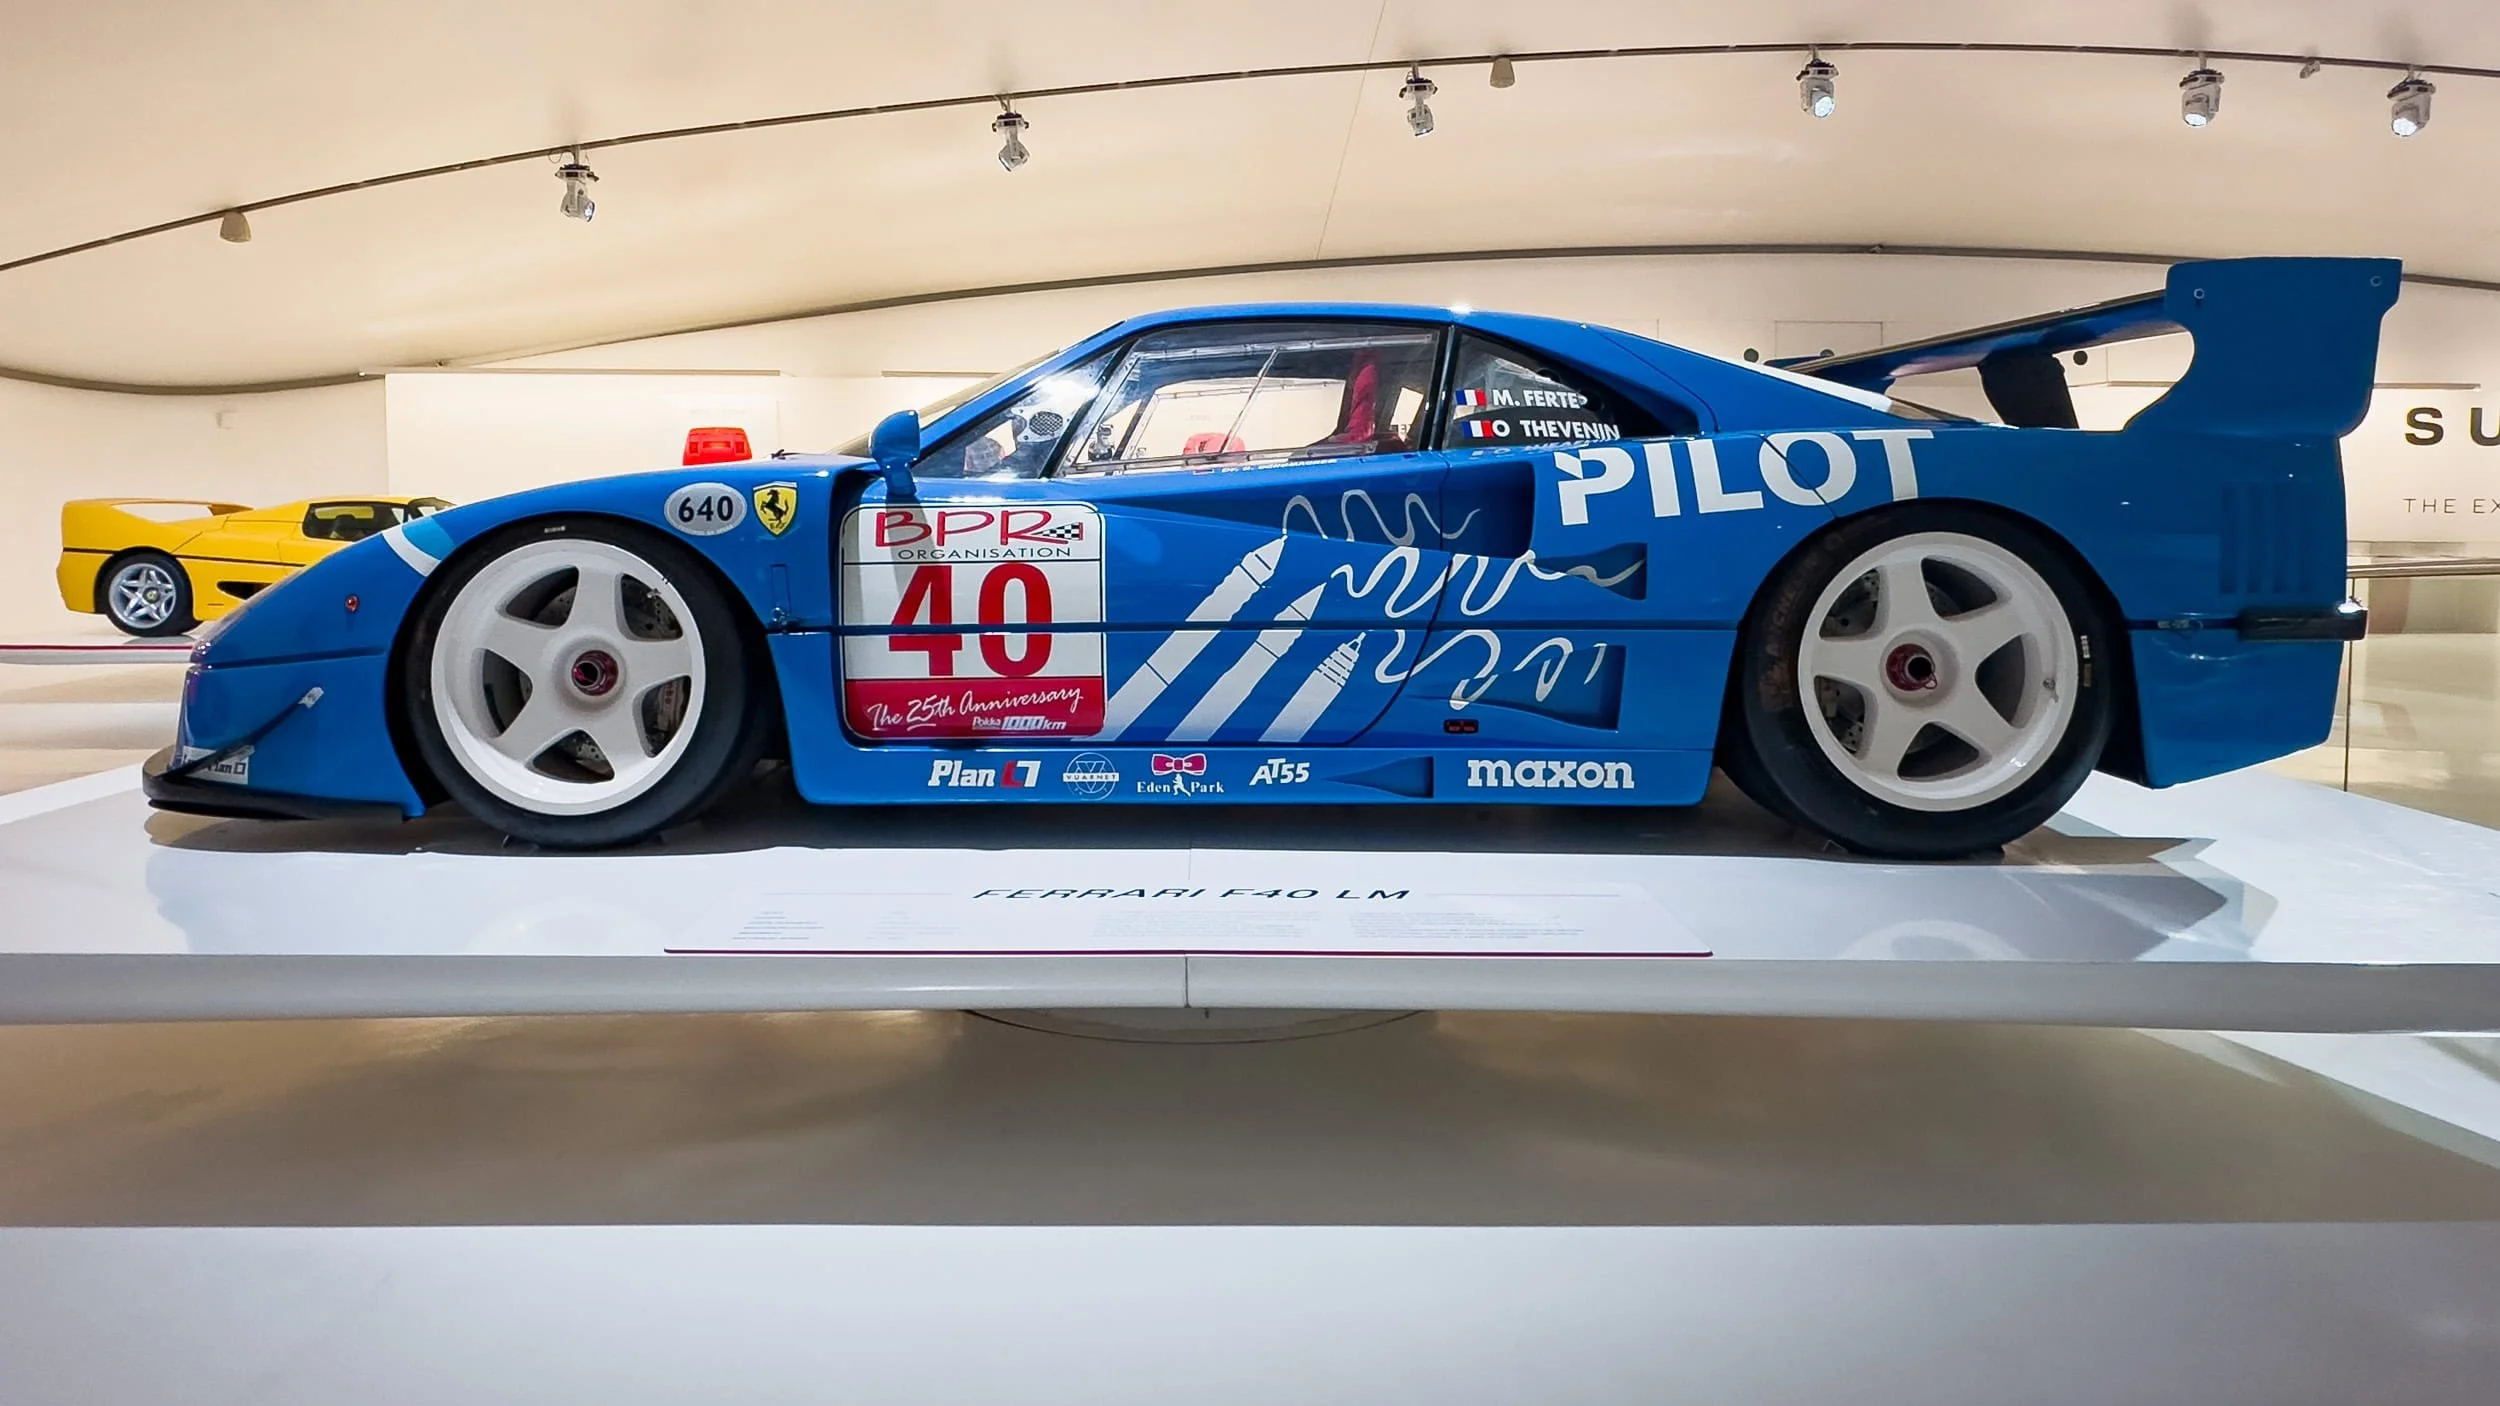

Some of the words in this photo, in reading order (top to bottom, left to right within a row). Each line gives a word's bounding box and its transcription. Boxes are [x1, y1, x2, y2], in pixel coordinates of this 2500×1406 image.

[1492, 389, 1521, 407] M.
[1519, 420, 1621, 441] THEVENIN
[1555, 429, 1934, 526] PILOT
[678, 495, 734, 523] 640
[2403, 498, 2457, 514] THE
[876, 510, 1069, 547] BPR
[898, 547, 1071, 560] ORGANISATION
[889, 562, 1053, 677] 40
[867, 703, 903, 731] The
[907, 695, 955, 725] 25th
[959, 687, 1084, 714] Anniversary
[927, 759, 996, 787] Plan
[1065, 773, 1117, 782] VUARNET
[1249, 758, 1310, 785] AT55
[1467, 759, 1635, 789] maxon
[1137, 781, 1171, 793] Eden
[1190, 781, 1224, 793] Park
[972, 888, 1206, 899] FERRARI
[1219, 888, 1319, 899] F40
[1336, 889, 1410, 899] LM
